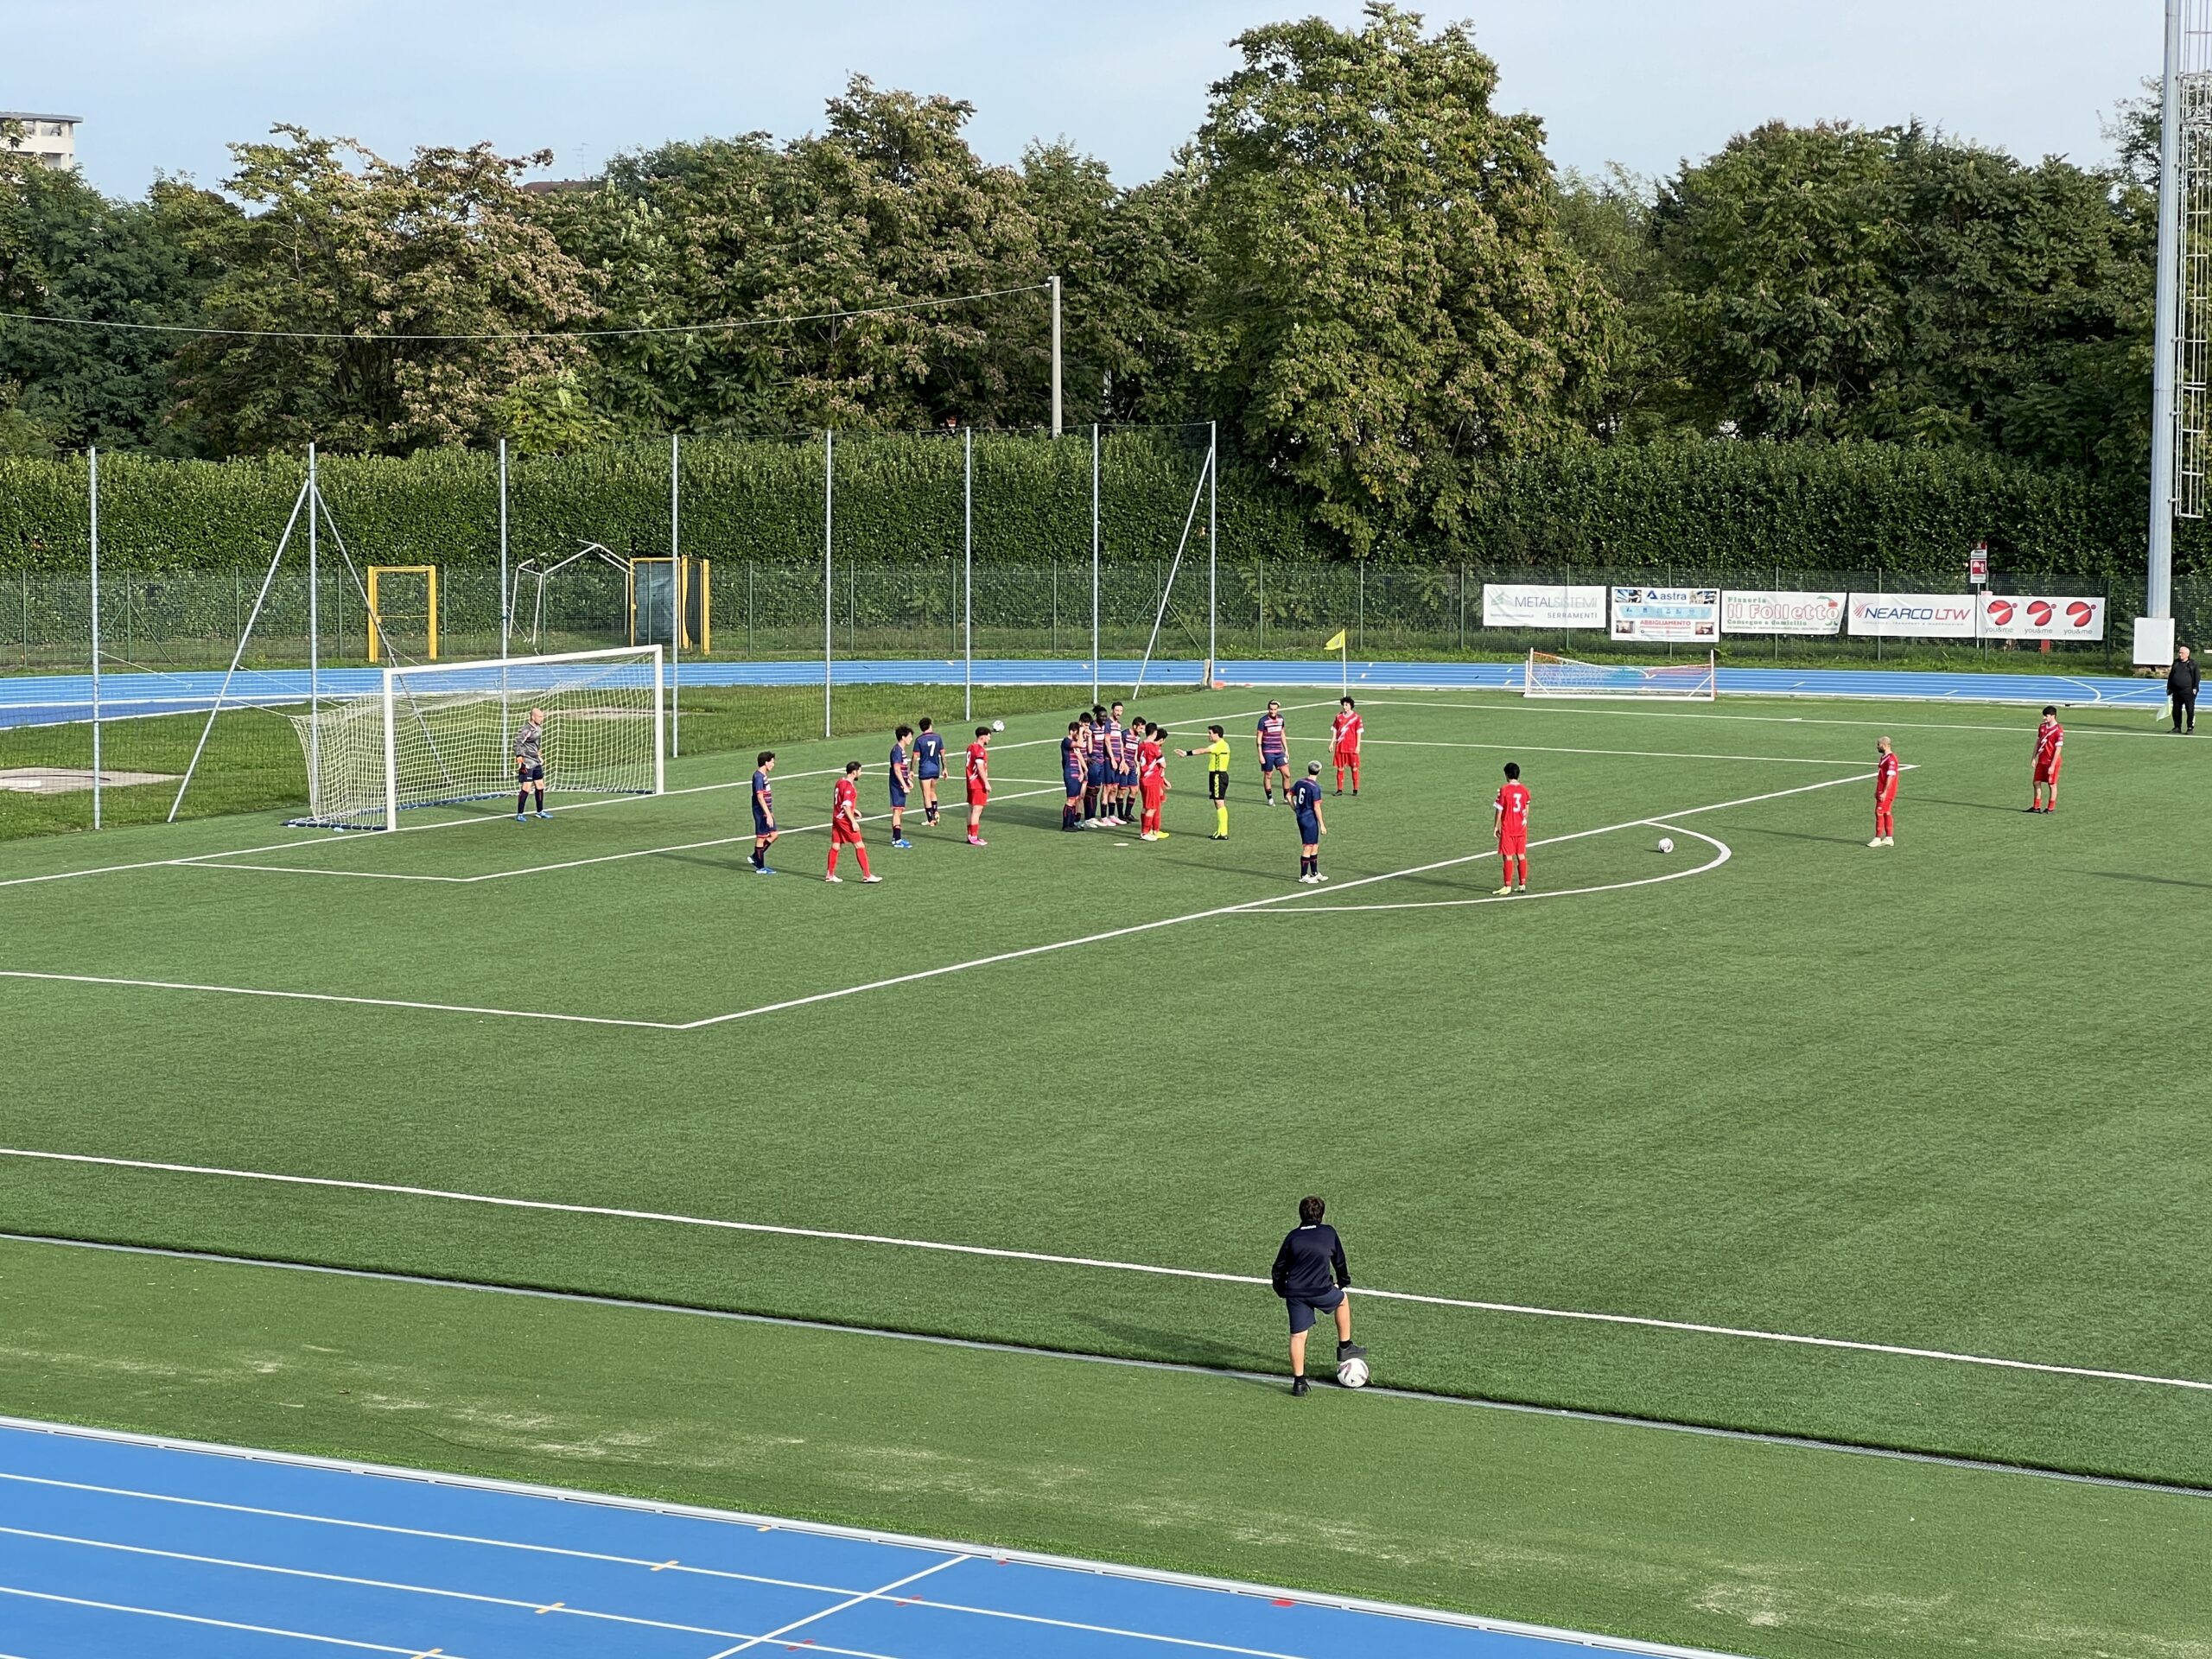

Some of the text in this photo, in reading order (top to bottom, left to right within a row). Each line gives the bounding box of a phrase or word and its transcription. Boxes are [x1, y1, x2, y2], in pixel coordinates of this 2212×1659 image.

[1515, 596, 1598, 608] METALSISTEMI
[1749, 603, 1840, 620] Folletto
[1865, 607, 1971, 620] NEARCO LTW
[2063, 628, 2093, 638] you&me
[927, 741, 937, 757] 7
[1298, 787, 1306, 804] 6
[1513, 793, 1522, 812] 3
